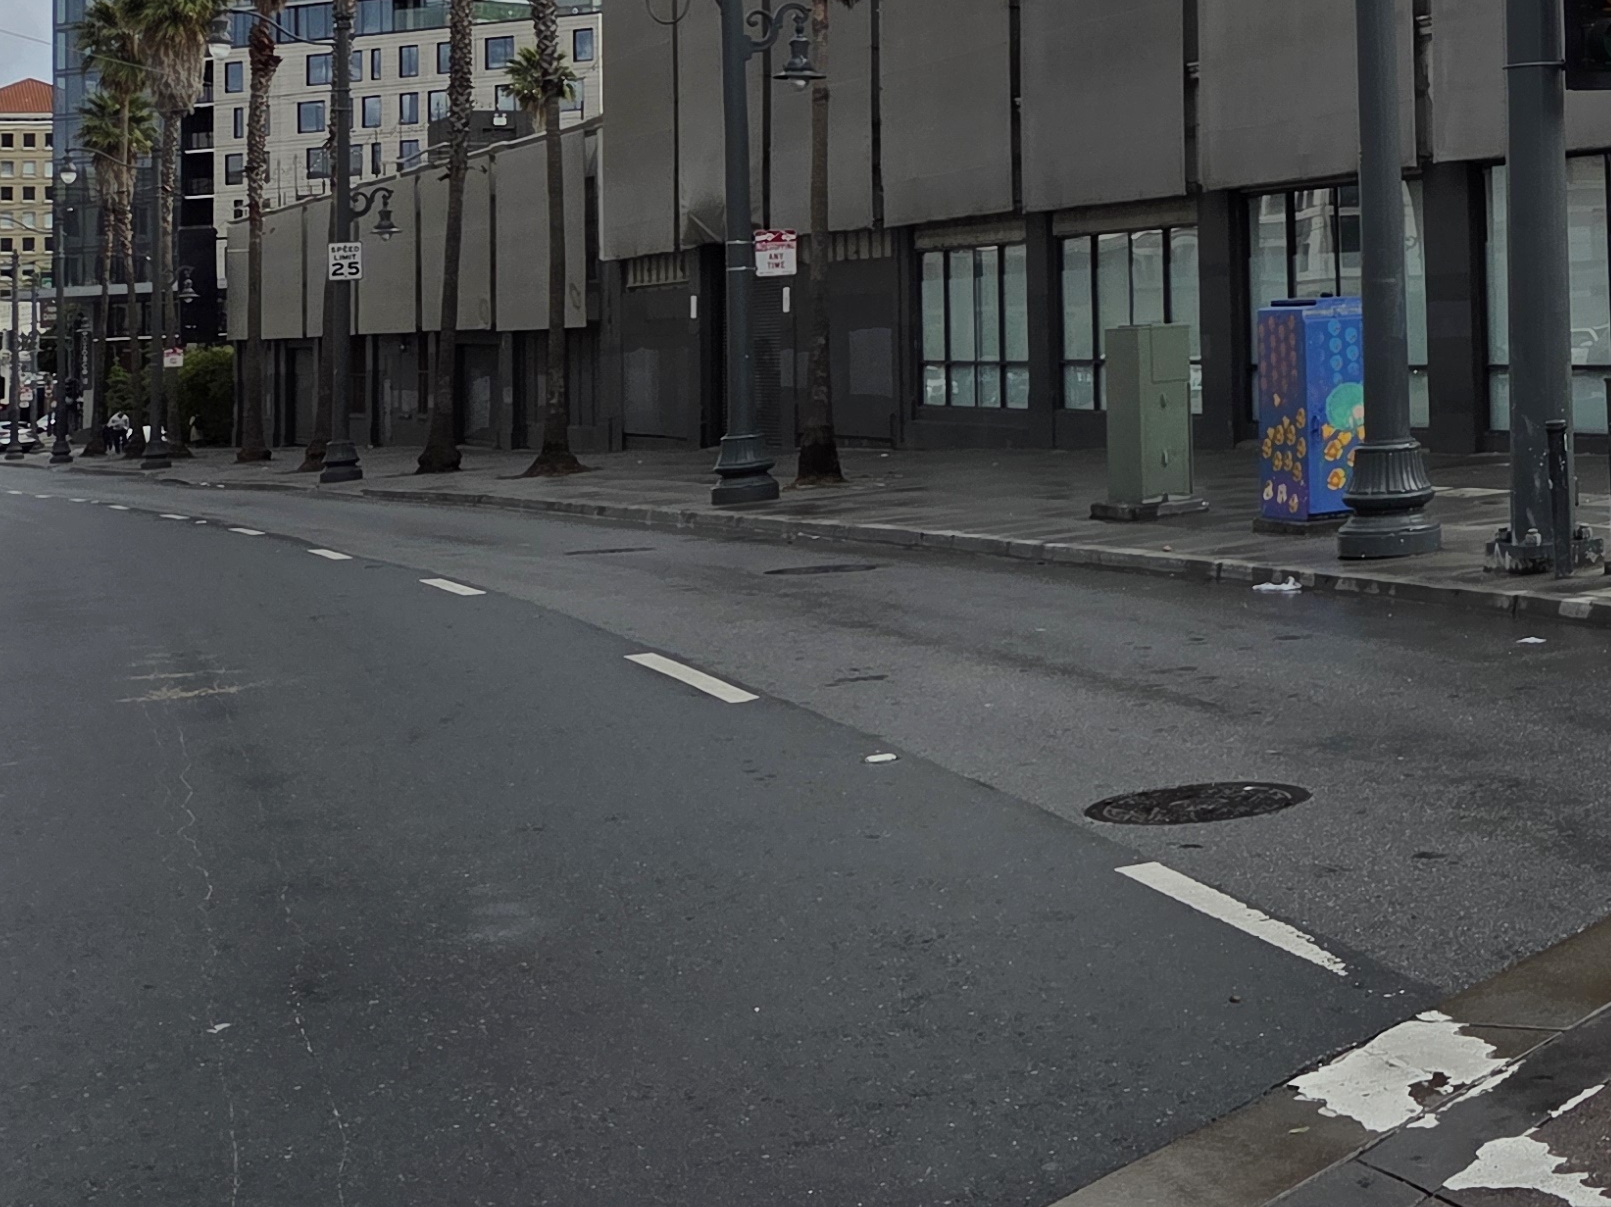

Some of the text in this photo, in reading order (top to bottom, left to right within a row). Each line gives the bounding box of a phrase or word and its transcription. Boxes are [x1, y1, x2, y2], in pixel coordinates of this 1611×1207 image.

[331, 245, 360, 253] SPEED
[333, 253, 357, 261] LIMIT
[768, 252, 784, 260] ANY
[331, 261, 360, 277] 25
[767, 261, 785, 269] TIME
